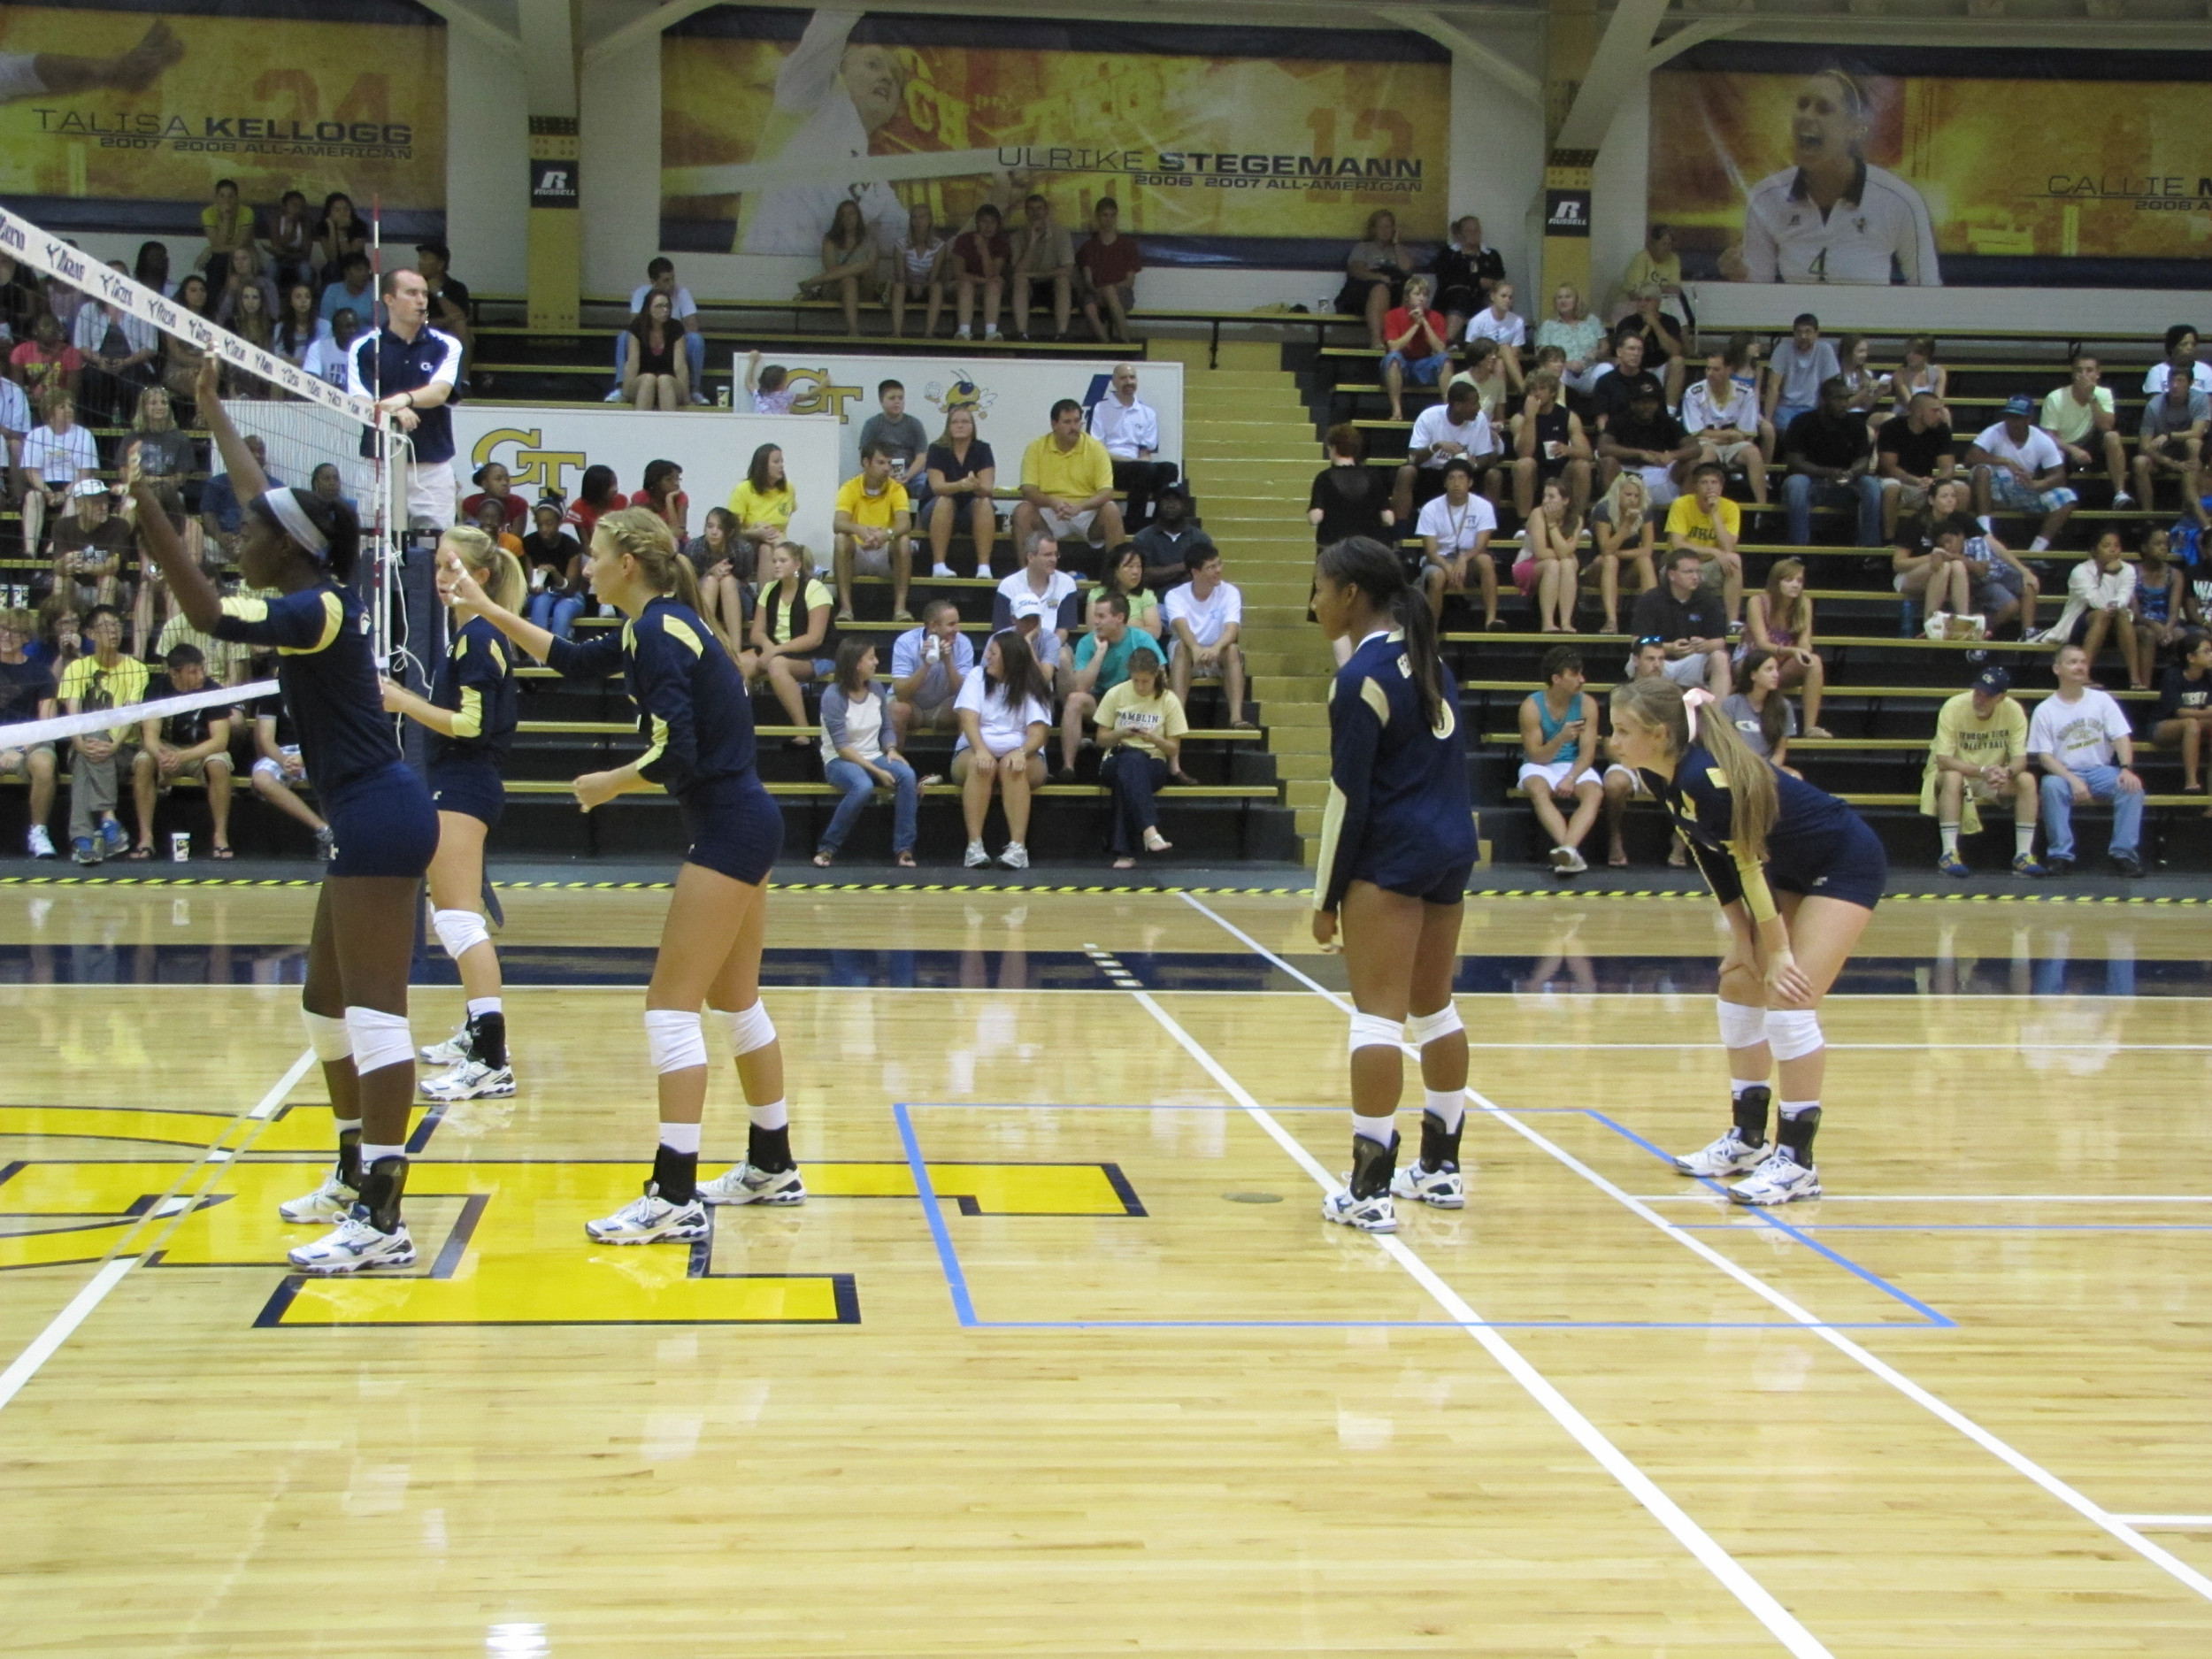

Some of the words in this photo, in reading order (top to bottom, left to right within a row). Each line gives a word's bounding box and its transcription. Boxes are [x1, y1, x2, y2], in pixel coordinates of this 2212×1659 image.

[32, 108, 191, 136] TALISA
[204, 116, 413, 145] KELLOGG
[99, 136, 162, 150] 2007
[173, 138, 237, 153] 2008
[242, 142, 413, 160] ALL-AMERICAN
[998, 147, 1143, 171] ULRIKE
[1158, 152, 1422, 178] STEGEMANN
[1134, 175, 1194, 188] 2006
[1204, 177, 1259, 189] 2007
[1265, 178, 1422, 193] ALL-AMERICAN
[2047, 175, 2185, 196] CALLIE
[2134, 200, 2192, 211] 2008
[1808, 247, 1828, 281] 4
[472, 428, 586, 500] GT
